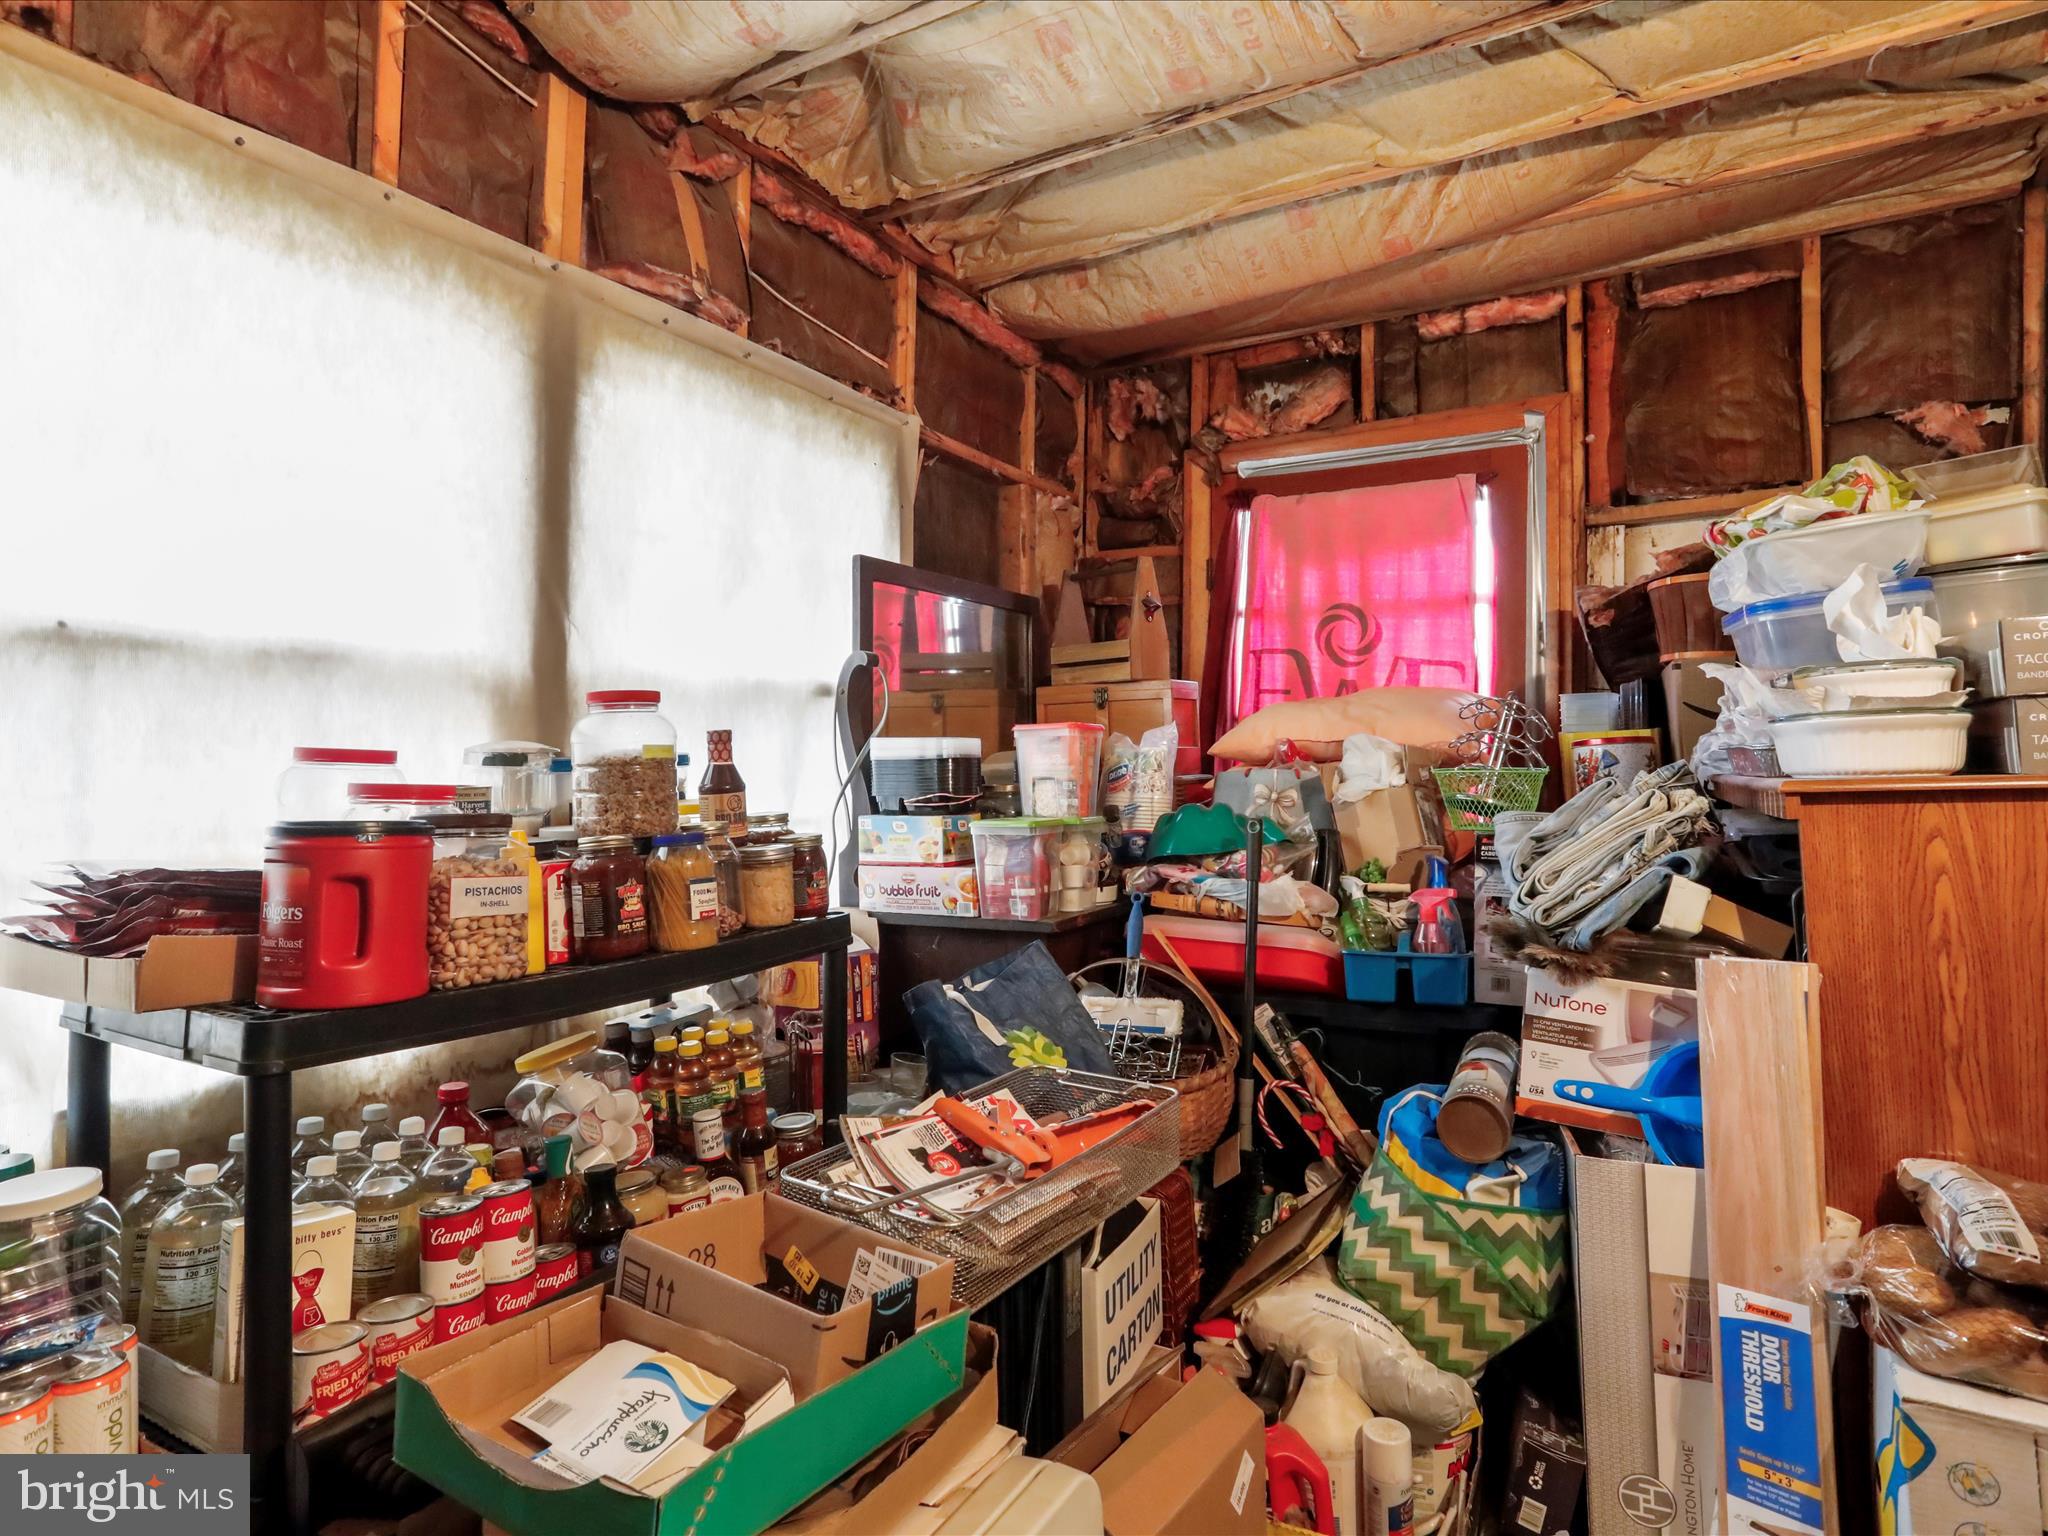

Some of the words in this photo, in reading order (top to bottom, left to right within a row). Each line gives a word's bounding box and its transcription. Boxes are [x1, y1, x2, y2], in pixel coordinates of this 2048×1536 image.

[464, 885, 523, 897] PISTACHIOS
[879, 883, 914, 898] bubble
[915, 883, 942, 898] fruit
[262, 901, 303, 924] Folgers
[480, 899, 510, 908] IN-SHELL
[278, 937, 303, 949] Roast
[1533, 991, 1607, 1016] NuTone
[1528, 1087, 1545, 1096] USA
[356, 1216, 377, 1224] trition
[378, 1213, 399, 1222] Facts
[295, 1233, 317, 1245] bitty
[160, 1248, 195, 1258] Nutrition
[198, 1243, 220, 1255] Facts
[455, 1267, 479, 1281] Golden
[1105, 1231, 1157, 1325] UTILITY
[1349, 1303, 1394, 1334] oldnavy.com
[1745, 1301, 1769, 1317] Frost
[1769, 1308, 1790, 1322] King
[1106, 1282, 1160, 1387] CARTON
[375, 1349, 405, 1368] FRIED
[1760, 1333, 1782, 1385] DOOR
[316, 1377, 349, 1399] FRIED
[1741, 1329, 1765, 1432] THRESHOLD
[1681, 1444, 1695, 1486] HOME
